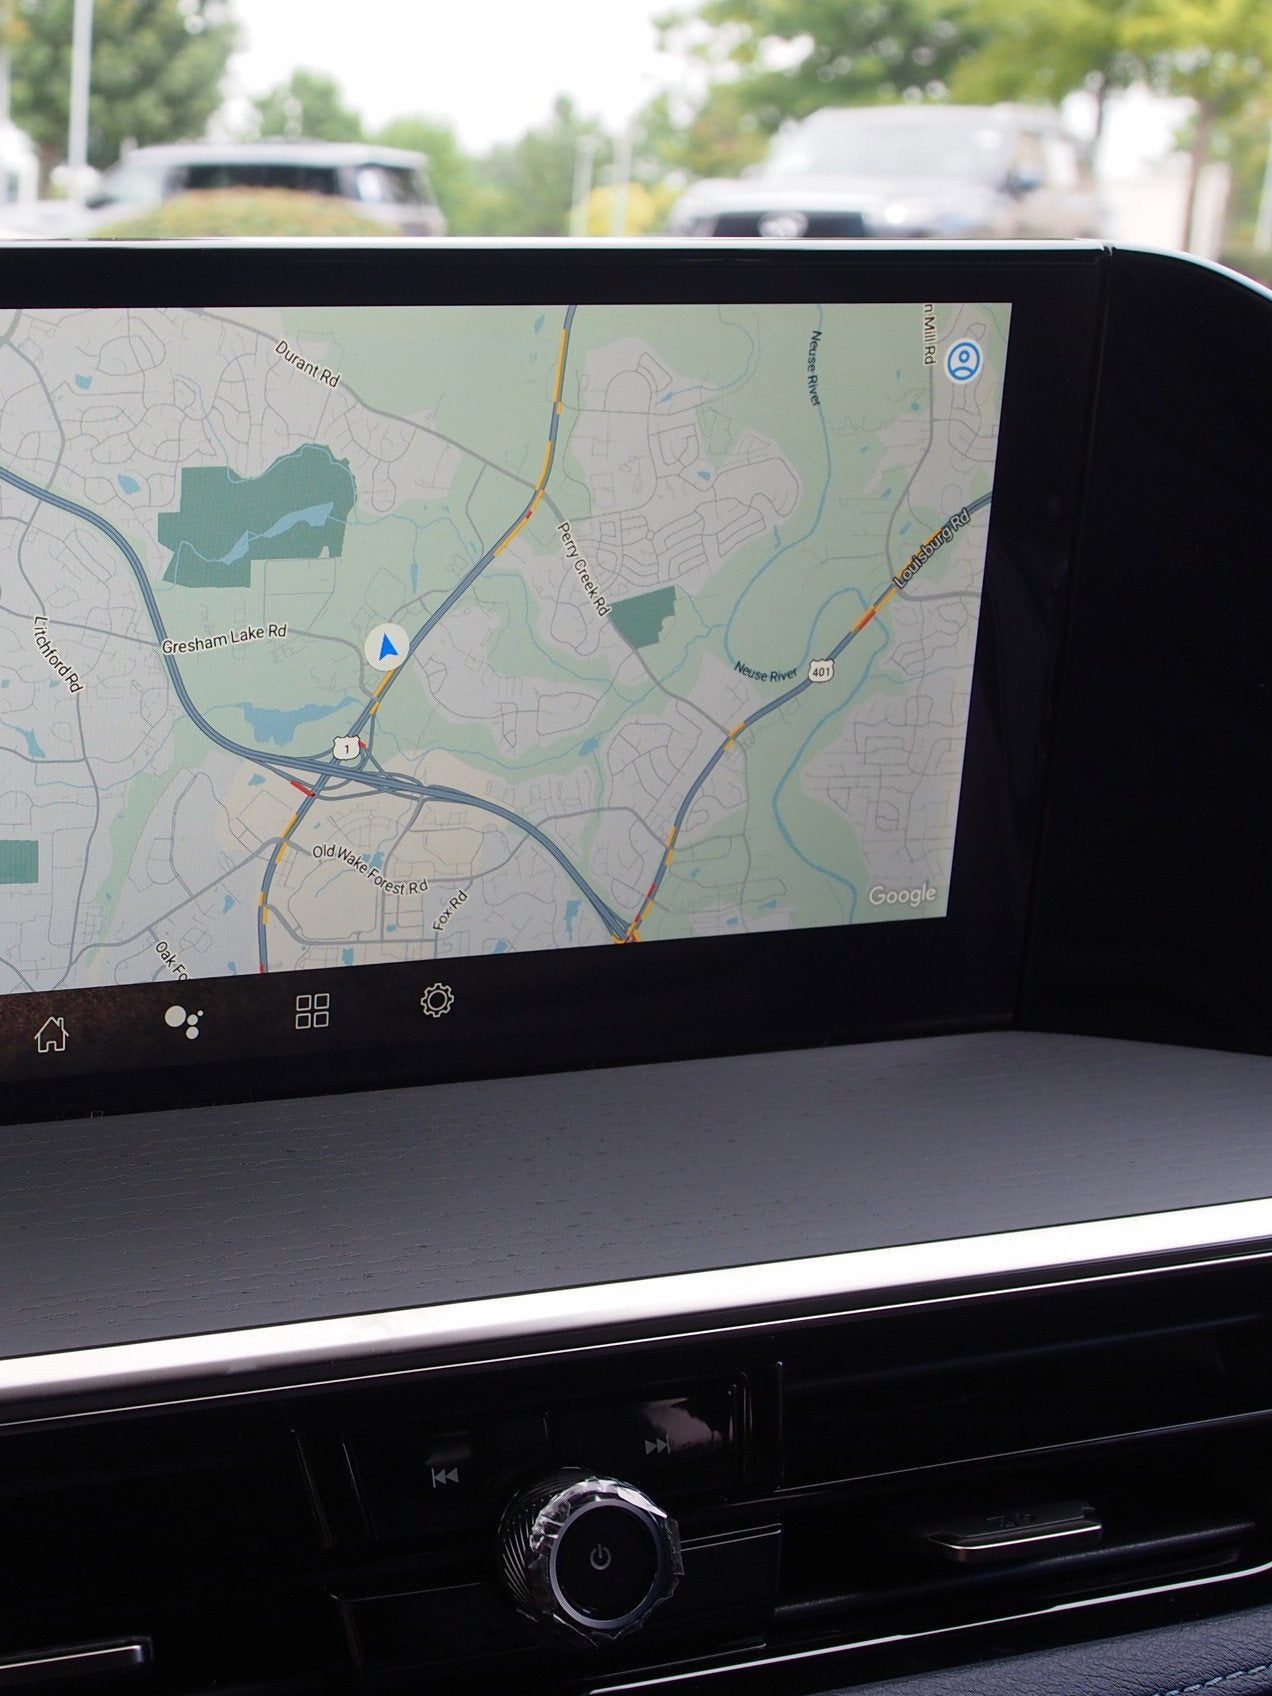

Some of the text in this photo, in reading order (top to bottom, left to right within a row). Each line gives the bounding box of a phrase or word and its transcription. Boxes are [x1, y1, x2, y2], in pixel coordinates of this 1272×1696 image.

[924, 316, 936, 342] Mill
[274, 339, 339, 388] Durant Rd
[807, 330, 822, 406] Neuse River
[924, 345, 936, 365] Rd
[893, 509, 971, 588] Louisburg Rd
[557, 521, 610, 617] Perry Creek Rd
[34, 615, 84, 693] Litchford Rd
[162, 624, 288, 654] Gresham Lake Rd
[734, 661, 798, 682] Neuse River
[812, 667, 831, 677] 401
[344, 745, 350, 754] 1
[313, 845, 430, 896] Old Wake Forest Rd
[869, 882, 936, 908] Google
[433, 890, 468, 931] Fox Rd
[156, 941, 177, 968] Oak
